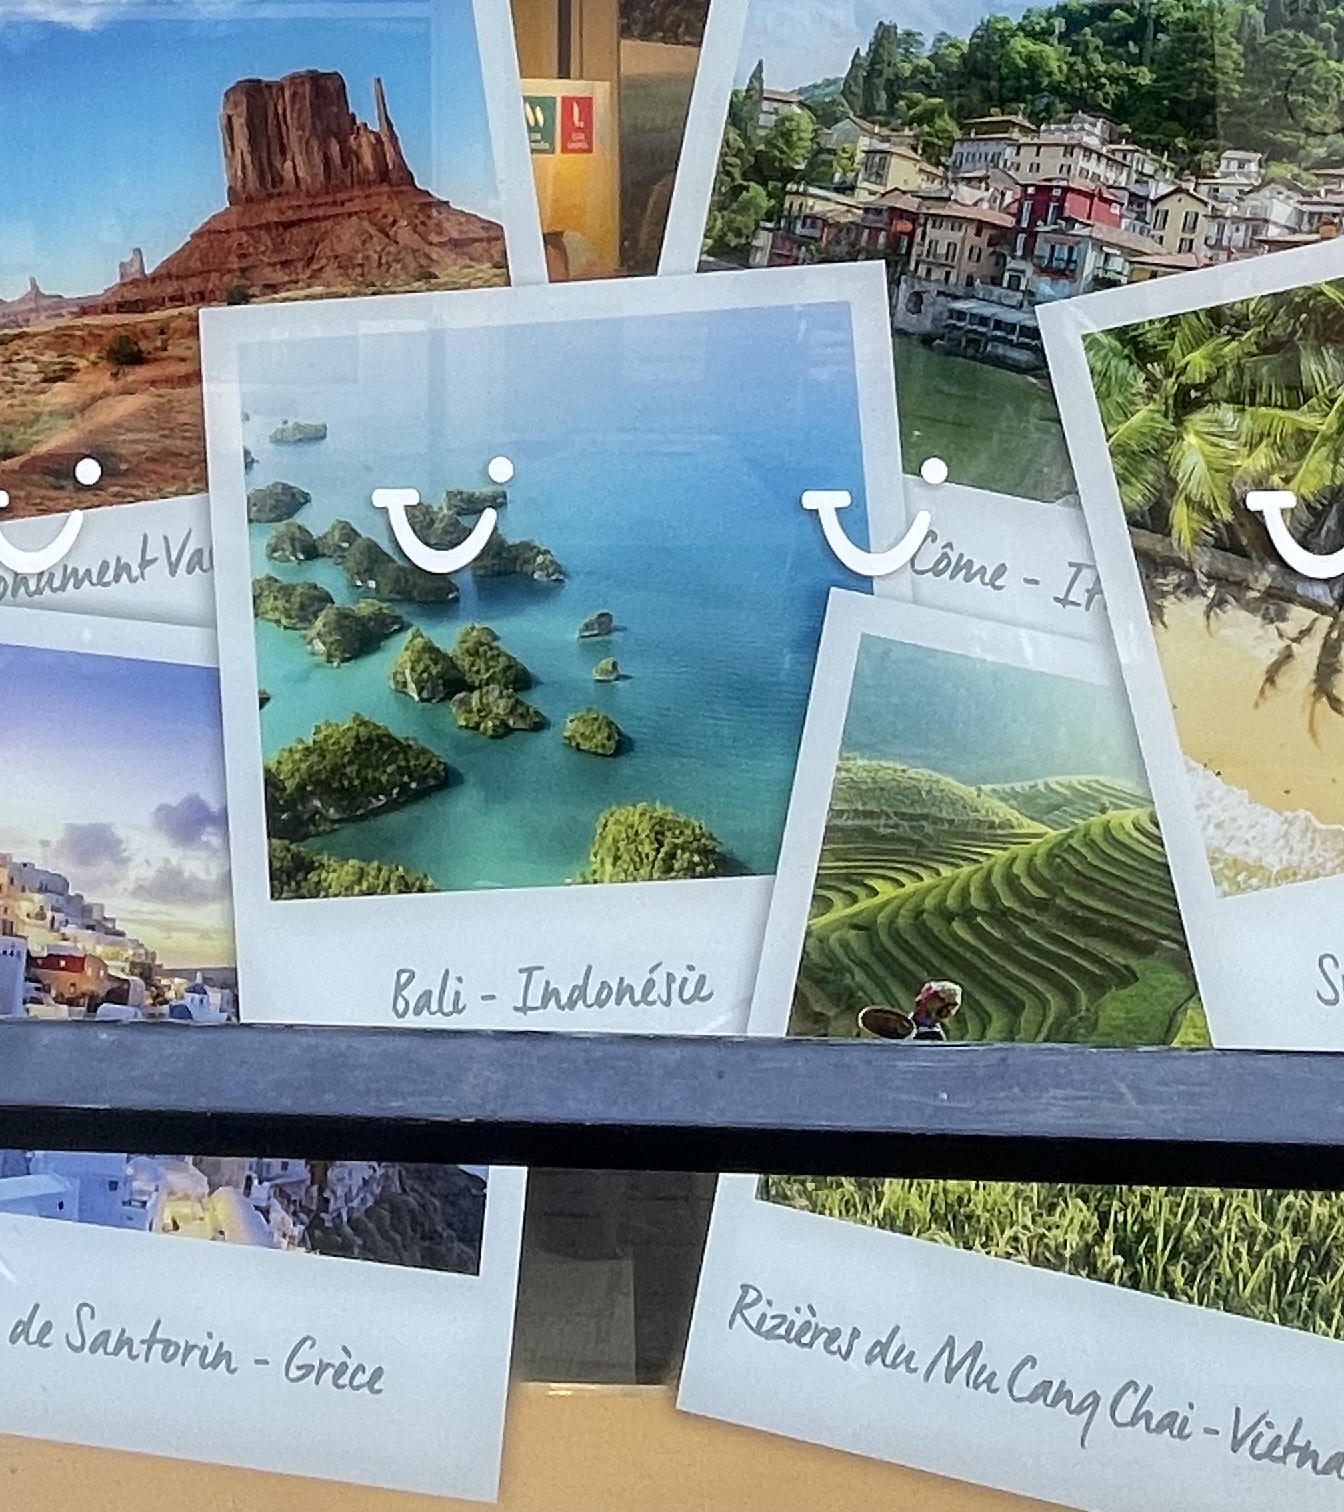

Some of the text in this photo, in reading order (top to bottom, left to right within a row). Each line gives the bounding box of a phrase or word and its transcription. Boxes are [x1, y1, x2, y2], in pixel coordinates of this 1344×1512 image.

[163, 527, 214, 577] Va
[910, 529, 1008, 591] Côme
[391, 967, 467, 1019] Bali
[512, 961, 714, 1016] Indonésie
[9, 1302, 53, 1348] de
[65, 1302, 239, 1376] Santorin
[284, 1335, 386, 1395] Grèce
[728, 1283, 861, 1361] Rizières
[864, 1324, 918, 1374] du
[923, 1334, 1000, 1394] Mu
[1007, 1353, 1102, 1449] Cang
[1109, 1378, 1194, 1440] Chai
